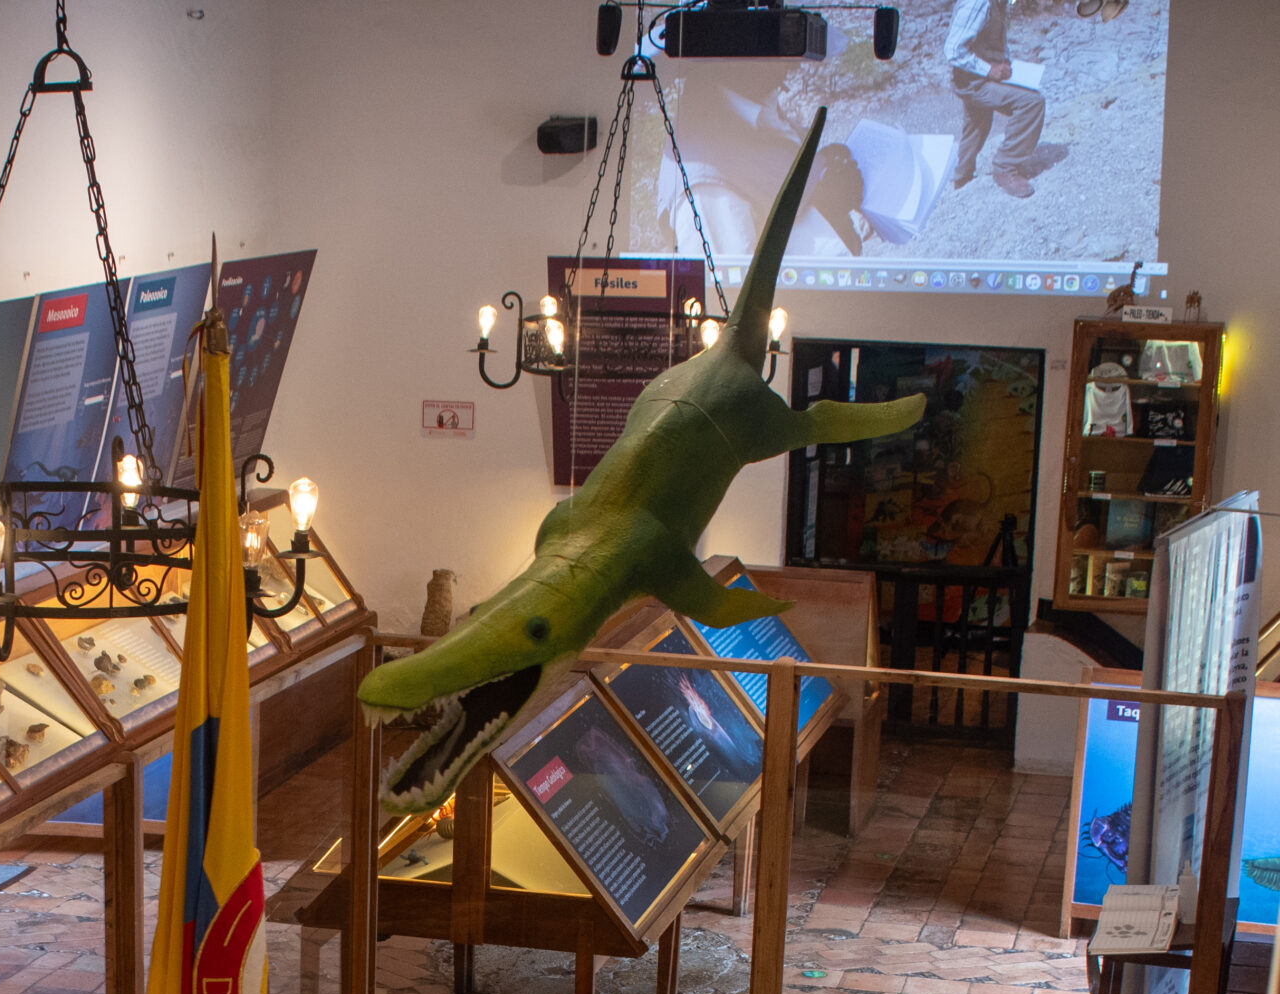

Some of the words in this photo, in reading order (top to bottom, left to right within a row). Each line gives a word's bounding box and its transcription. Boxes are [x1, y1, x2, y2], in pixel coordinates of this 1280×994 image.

[139, 287, 168, 304] Paleozoico
[46, 305, 79, 324] Mesozoico
[533, 780, 551, 796] Tiempo
